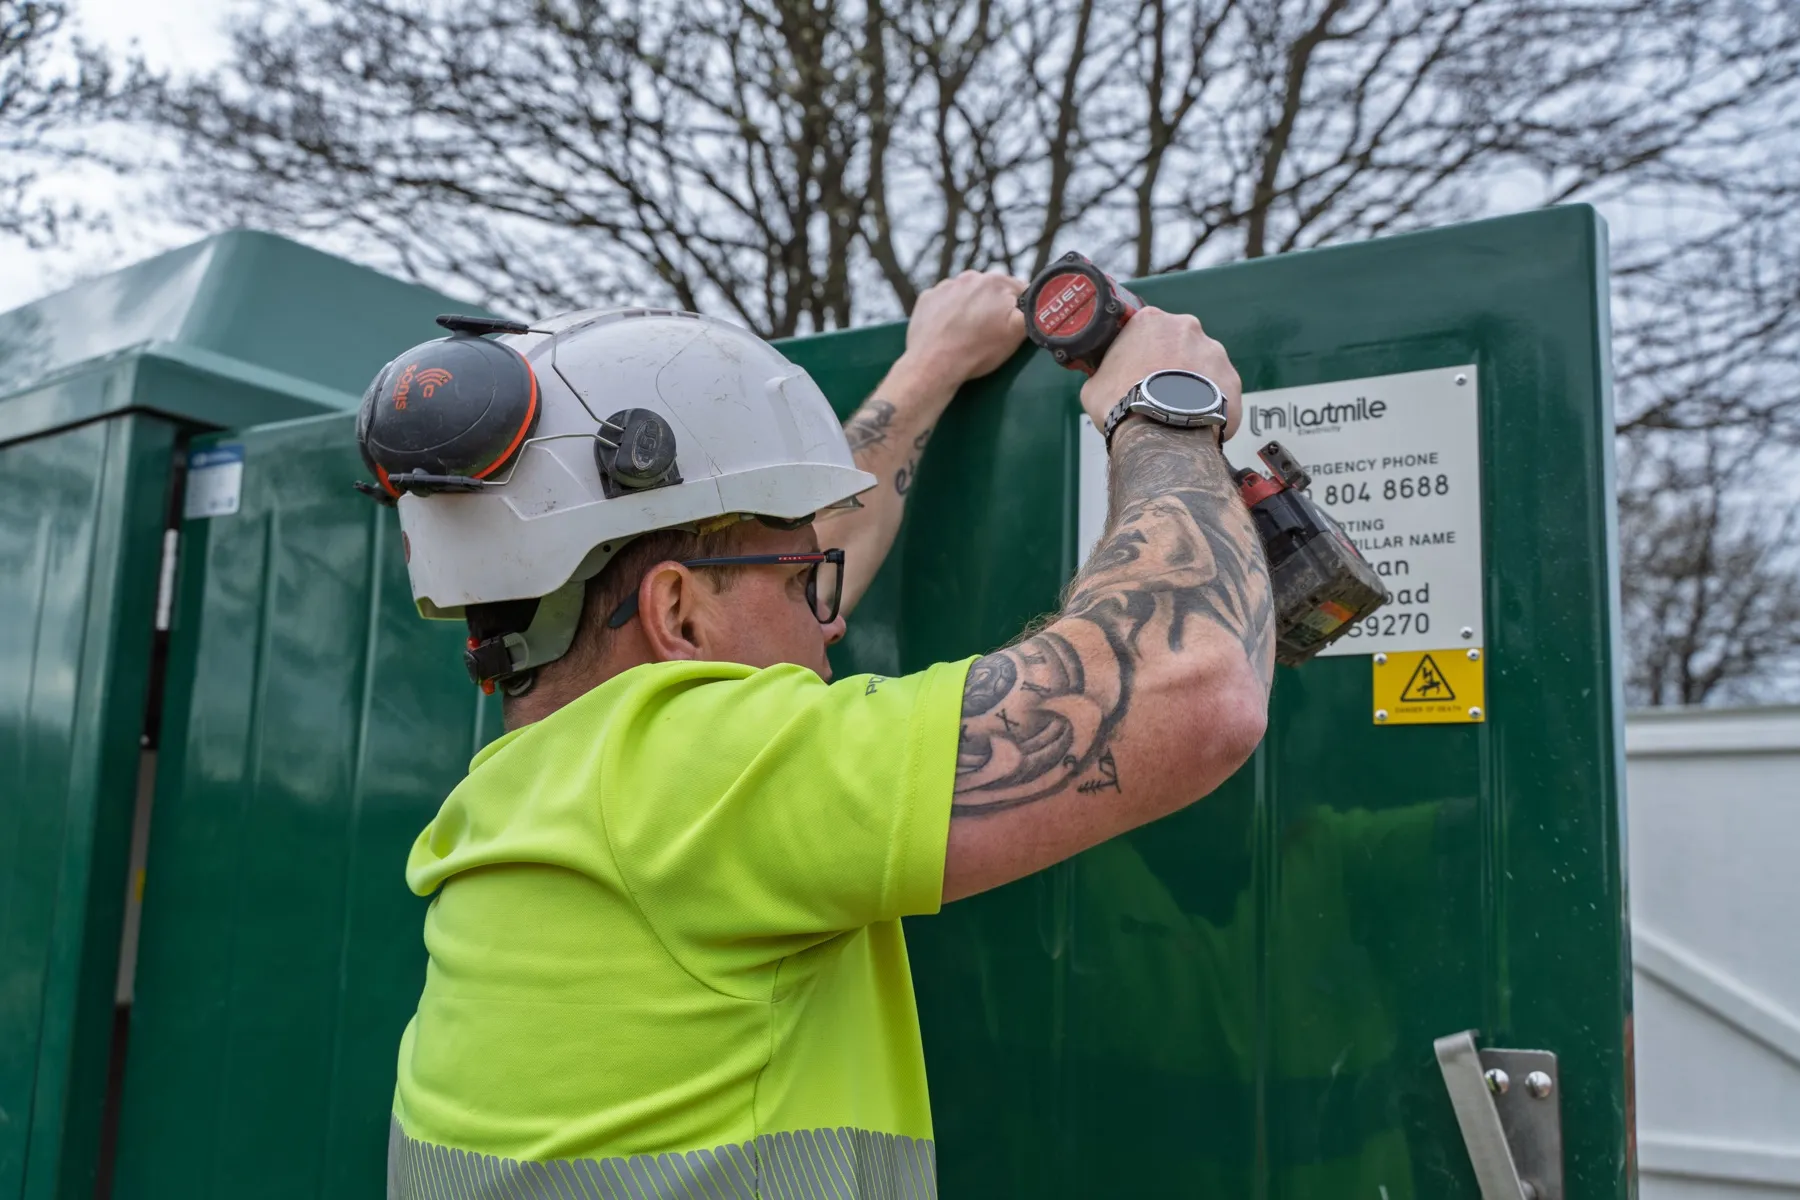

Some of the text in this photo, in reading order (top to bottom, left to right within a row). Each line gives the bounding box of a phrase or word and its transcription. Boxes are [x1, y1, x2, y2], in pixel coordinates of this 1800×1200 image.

[1039, 282, 1087, 323] FUEL
[1293, 396, 1387, 428] lastmile
[1302, 452, 1439, 476] ERGENCY PHONE
[1324, 481, 1372, 506] 804
[1383, 473, 1449, 500] 8688
[1409, 531, 1457, 547] NAME
[1384, 582, 1430, 606] oad
